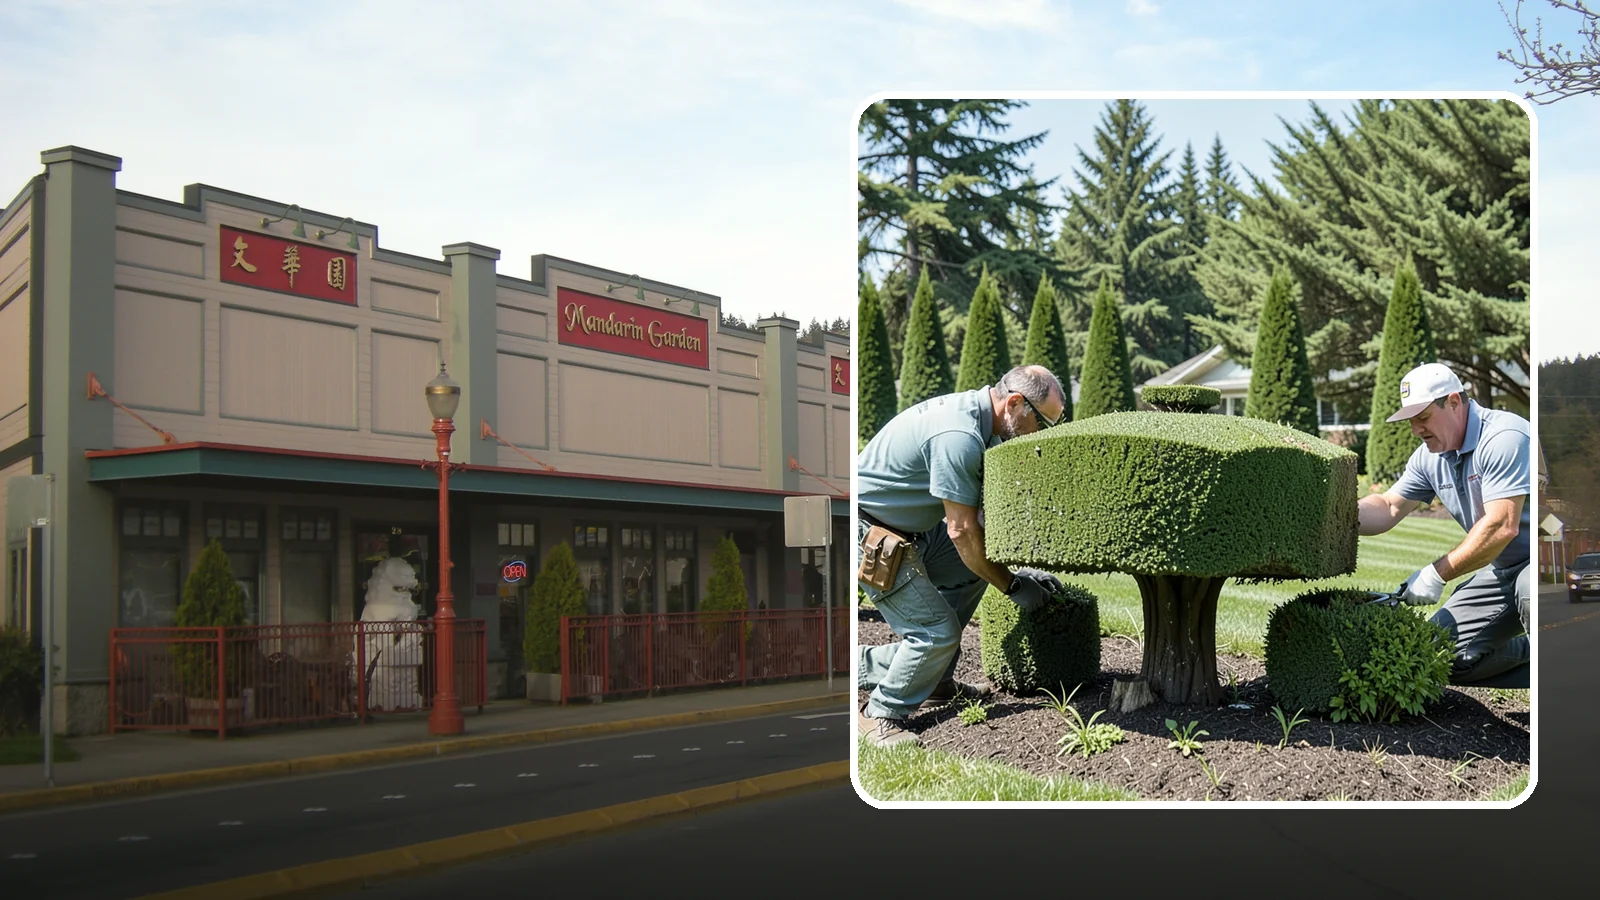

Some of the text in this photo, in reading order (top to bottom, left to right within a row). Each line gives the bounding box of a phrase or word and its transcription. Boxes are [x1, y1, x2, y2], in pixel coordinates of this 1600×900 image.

[230, 235, 346, 291] 文華園
[564, 302, 701, 352] Mandarin Garden
[503, 565, 527, 578] OPEN
